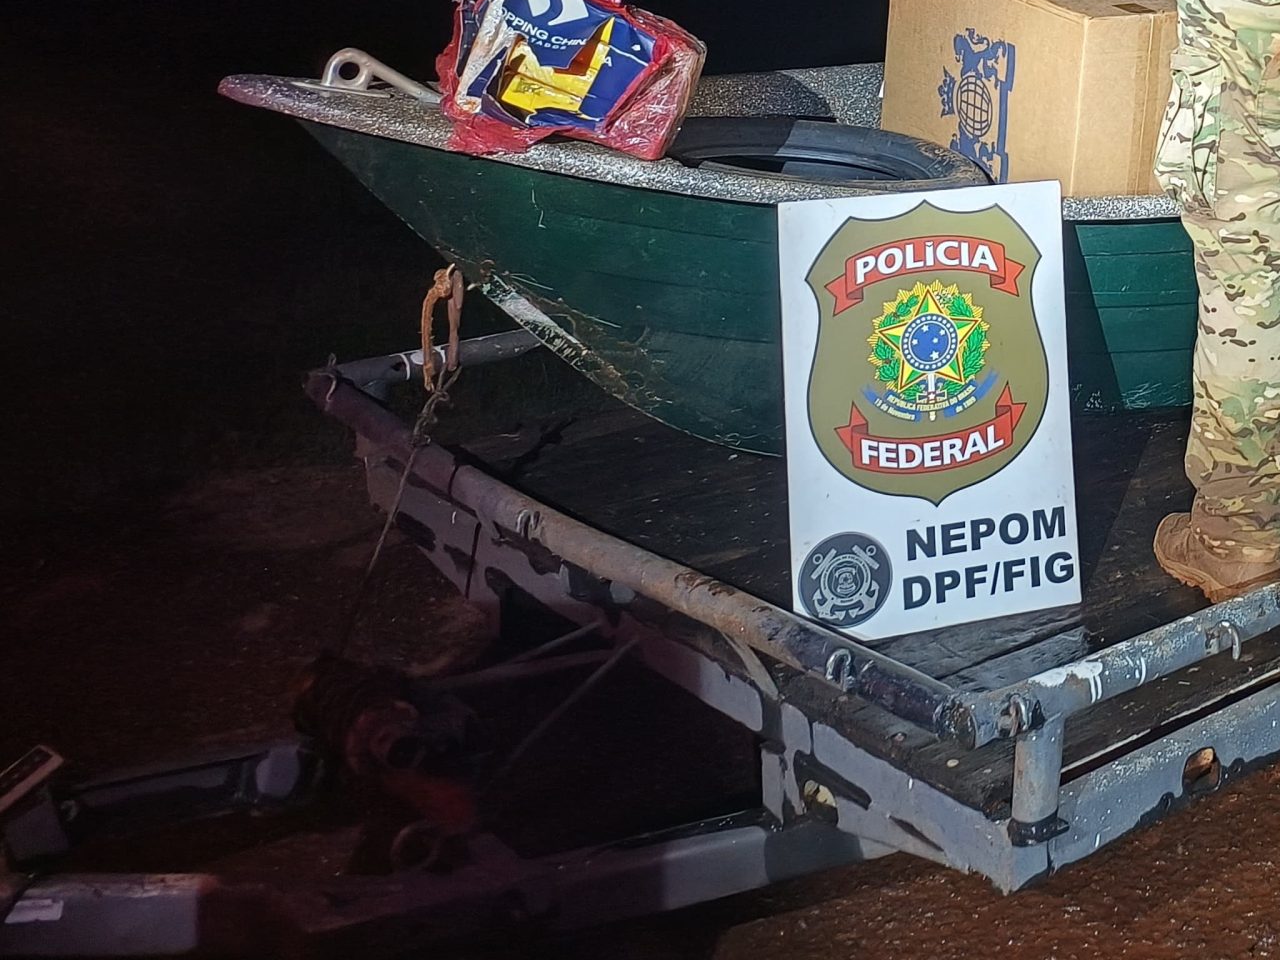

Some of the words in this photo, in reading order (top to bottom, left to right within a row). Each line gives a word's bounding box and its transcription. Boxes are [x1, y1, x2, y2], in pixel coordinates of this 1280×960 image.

[501, 6, 549, 41] OPPING
[860, 424, 1005, 469] FEDERAL
[906, 506, 1067, 561] NEPOM
[902, 551, 1075, 611] DPF/FIG
